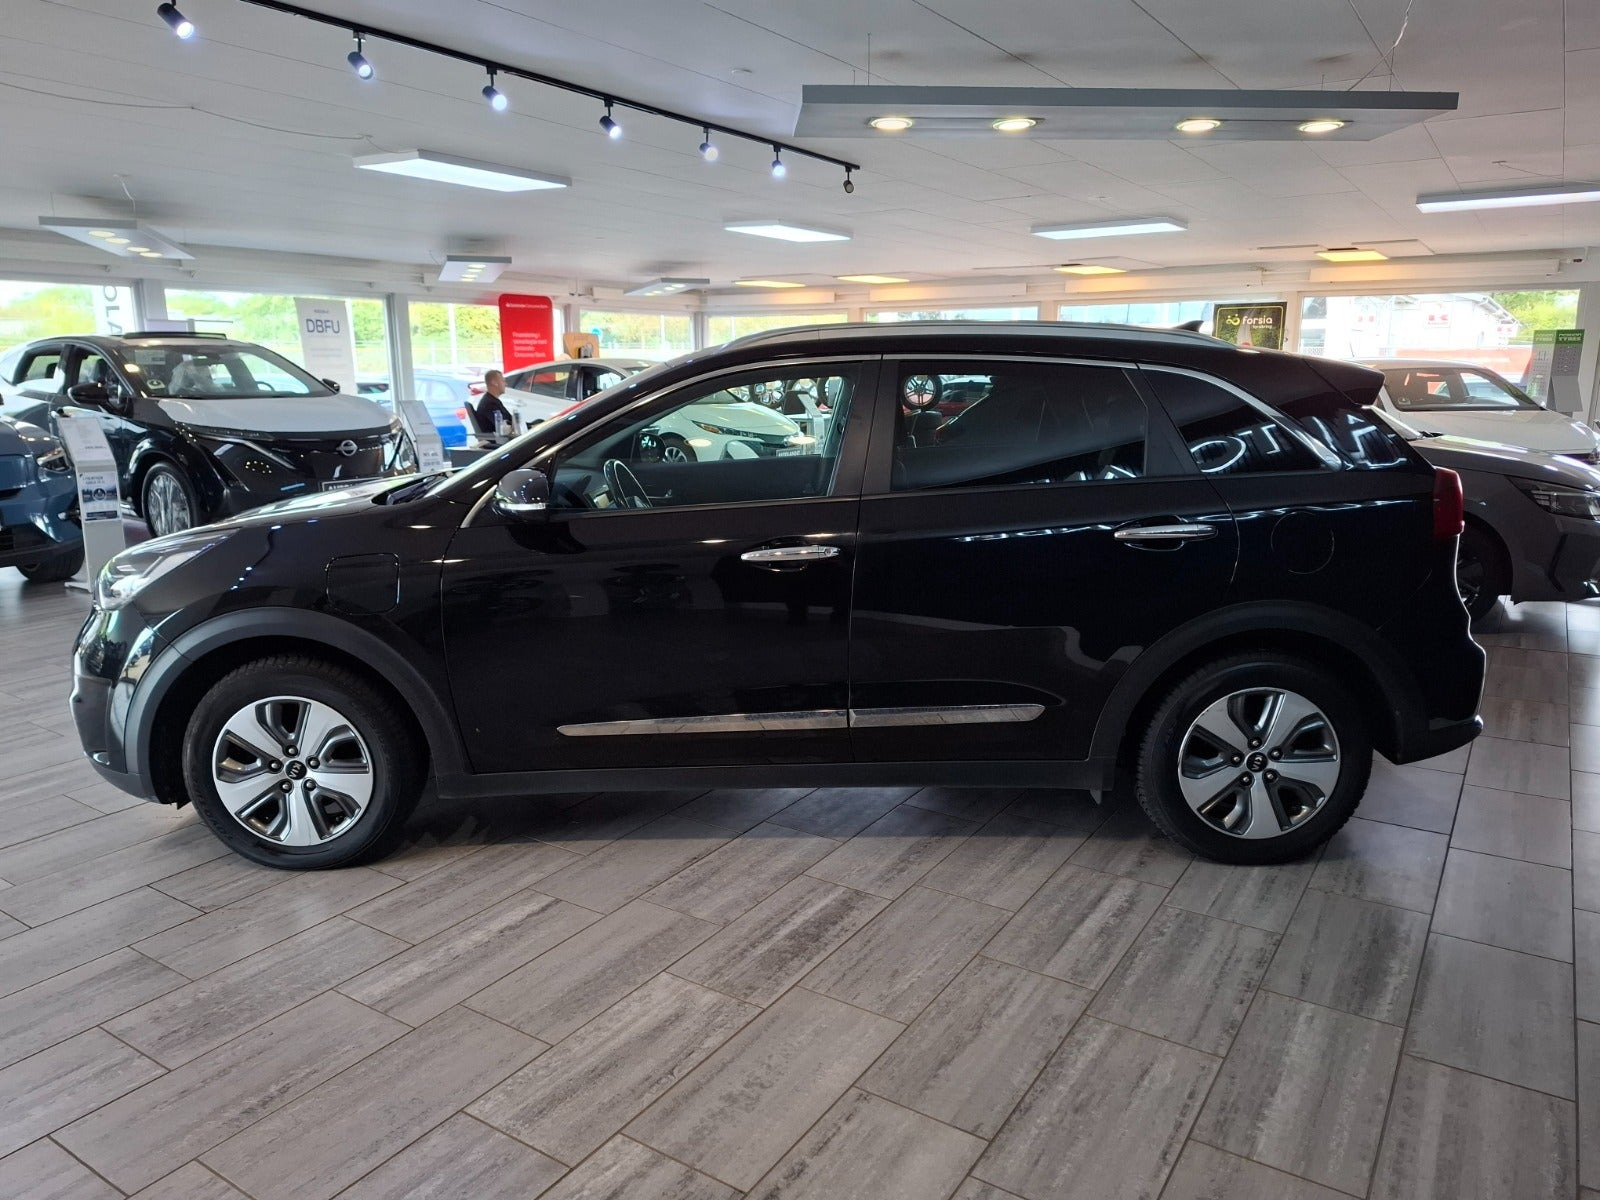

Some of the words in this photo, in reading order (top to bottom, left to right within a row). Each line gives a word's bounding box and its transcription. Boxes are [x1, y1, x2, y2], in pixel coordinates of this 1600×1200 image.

[306, 318, 341, 334] DBFU
[1242, 315, 1273, 325] forsia
[288, 762, 302, 778] KIA
[1252, 755, 1264, 770] KIA
